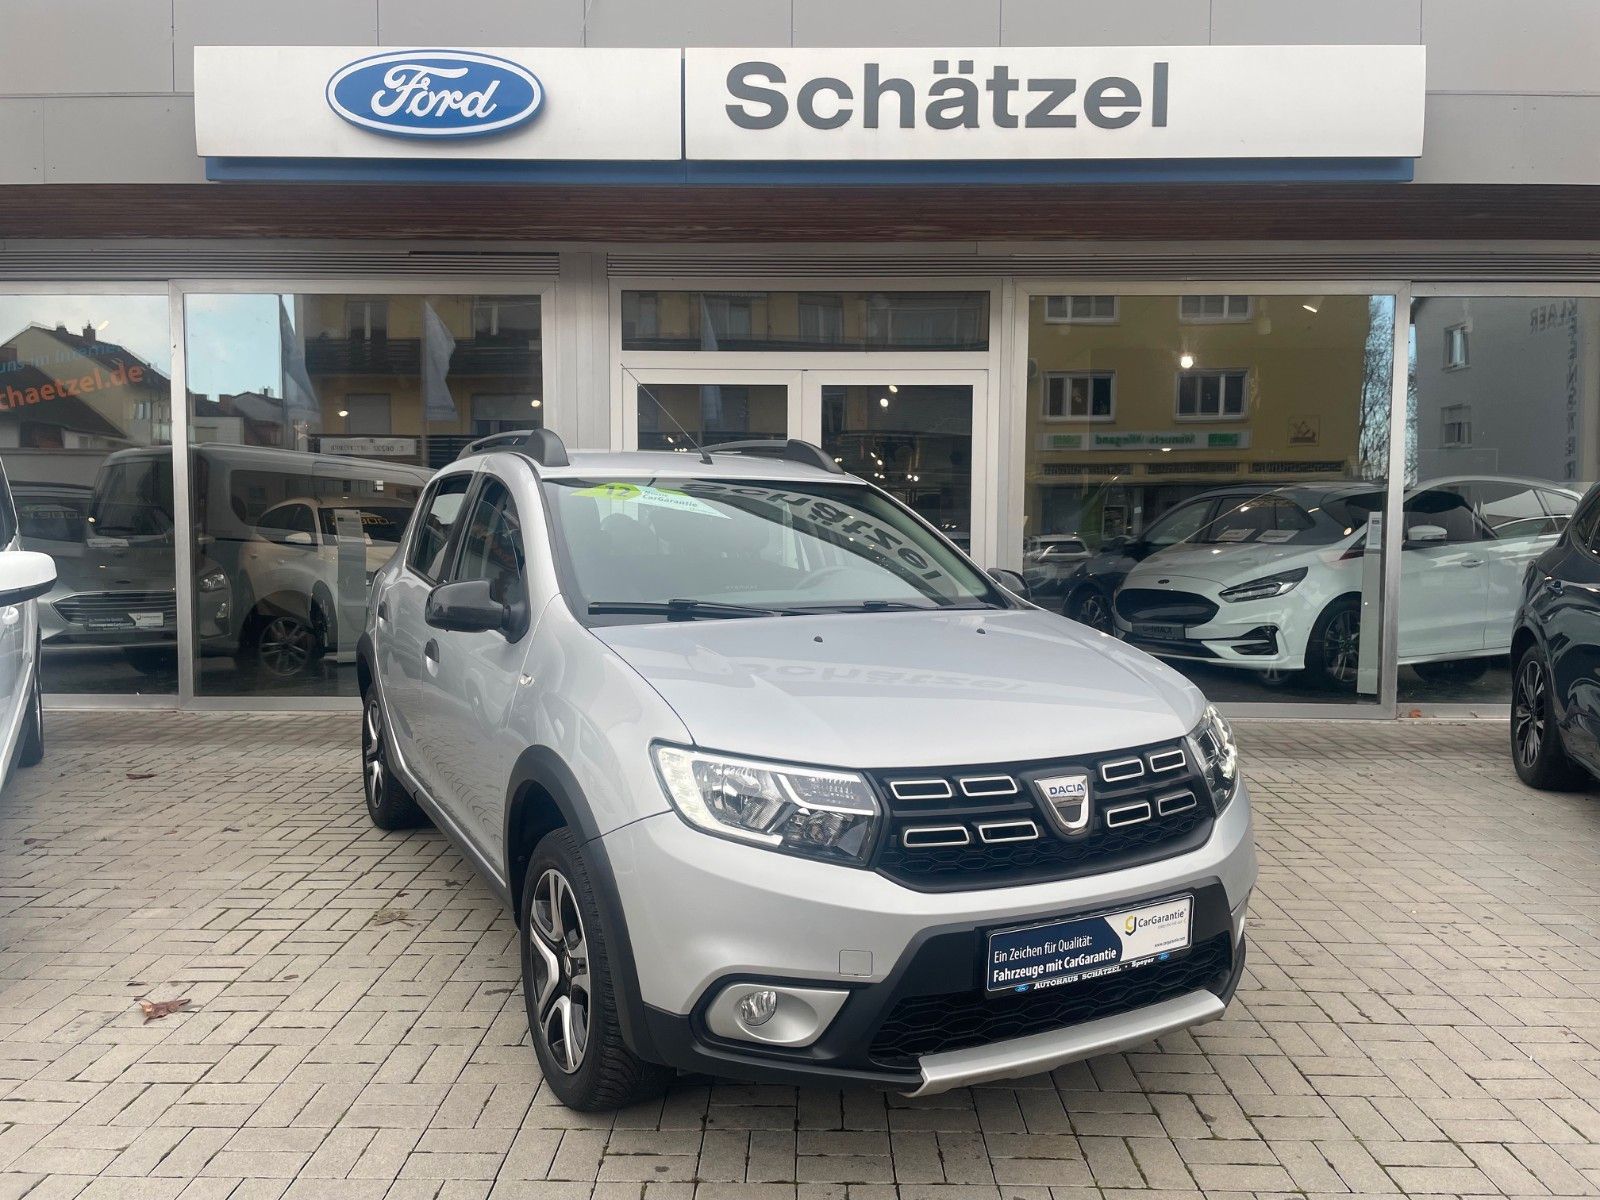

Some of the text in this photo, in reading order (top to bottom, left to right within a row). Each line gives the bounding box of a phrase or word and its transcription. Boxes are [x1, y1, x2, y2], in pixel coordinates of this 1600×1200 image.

[371, 64, 500, 118] Ford
[725, 60, 1169, 130] Schätzel
[1049, 783, 1084, 795] DACIA
[993, 948, 1117, 983] Fahrzeuge mit CarGarantie
[994, 935, 1093, 964] Ein Zeichen für Qualität:
[1034, 974, 1079, 990] AUTOHAUS
[1131, 957, 1155, 969] Speyer
